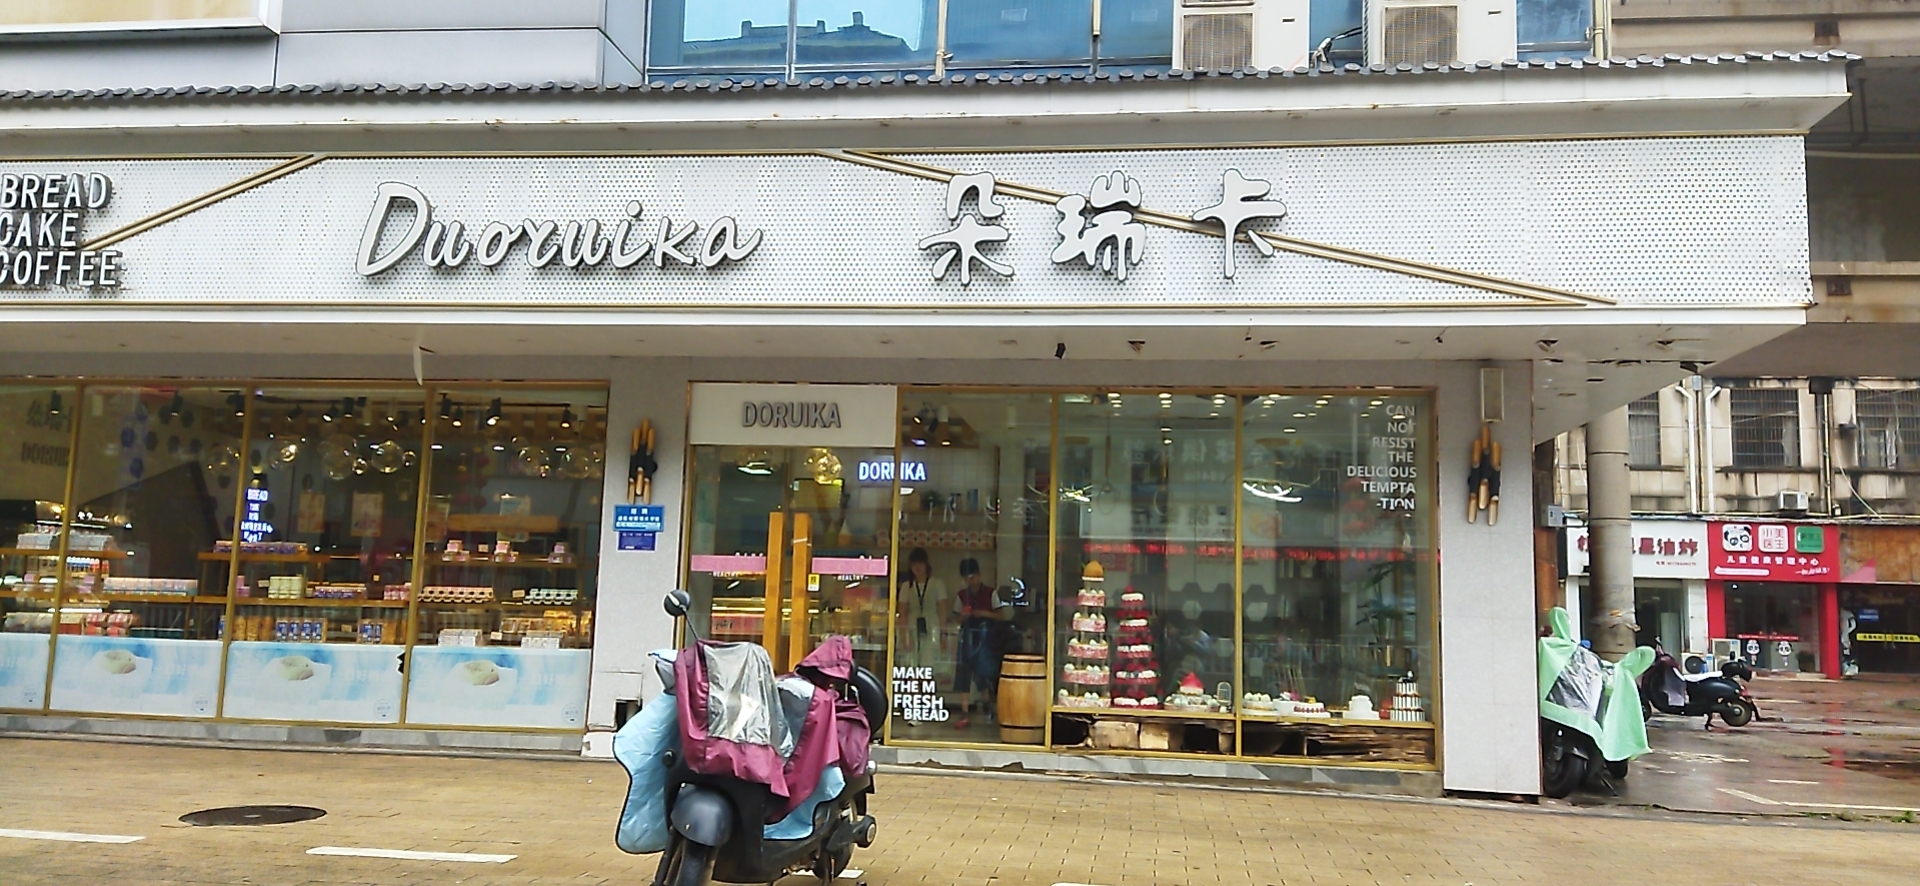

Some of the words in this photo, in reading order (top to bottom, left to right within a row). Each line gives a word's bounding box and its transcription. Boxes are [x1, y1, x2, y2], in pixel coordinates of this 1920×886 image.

[0, 173, 112, 209] BREAD
[0, 212, 80, 248] CAKE
[356, 181, 763, 277] Duoruika
[919, 169, 1287, 286] 朵瑞卡
[742, 402, 841, 428] DORUIKA
[1386, 404, 1415, 417] CAN
[1387, 421, 1416, 434] NOT
[1372, 437, 1416, 449] RESIST
[1388, 451, 1414, 463] THE
[1347, 465, 1417, 479] DELICIOUS
[1361, 480, 1416, 494] TEMPTA
[893, 667, 933, 679] MAKE
[892, 680, 919, 693] THE
[922, 680, 936, 693] M
[894, 694, 944, 709] FRESH
[904, 708, 950, 722] BREAD
